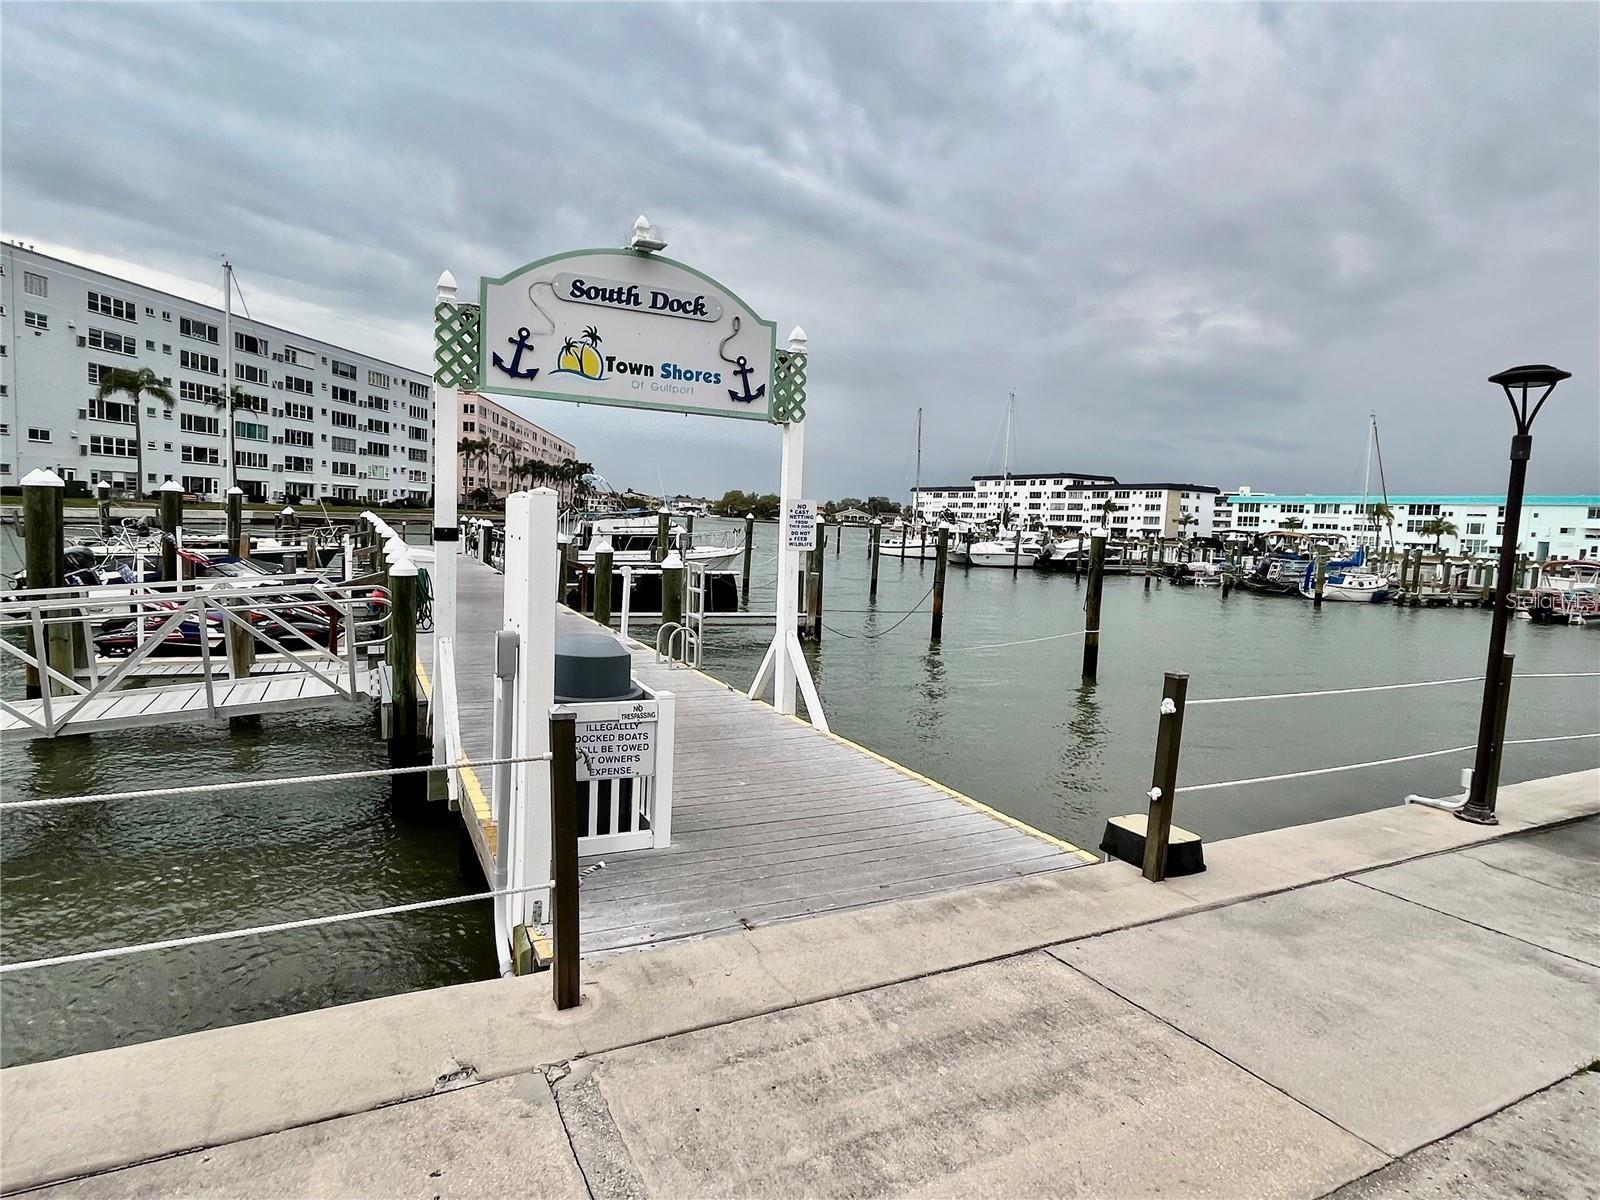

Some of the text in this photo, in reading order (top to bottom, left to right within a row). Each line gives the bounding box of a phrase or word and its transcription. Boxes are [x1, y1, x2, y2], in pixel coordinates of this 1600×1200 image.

[570, 279, 708, 316] South Dock
[606, 356, 722, 384] Town Shores
[631, 380, 694, 395] Of Gulfport
[621, 712, 656, 720] TRESPASSING
[575, 732, 648, 743] DOCKED BOATS
[601, 745, 613, 753] BE
[616, 743, 649, 752] TOWED
[598, 755, 640, 763] OWNER'S
